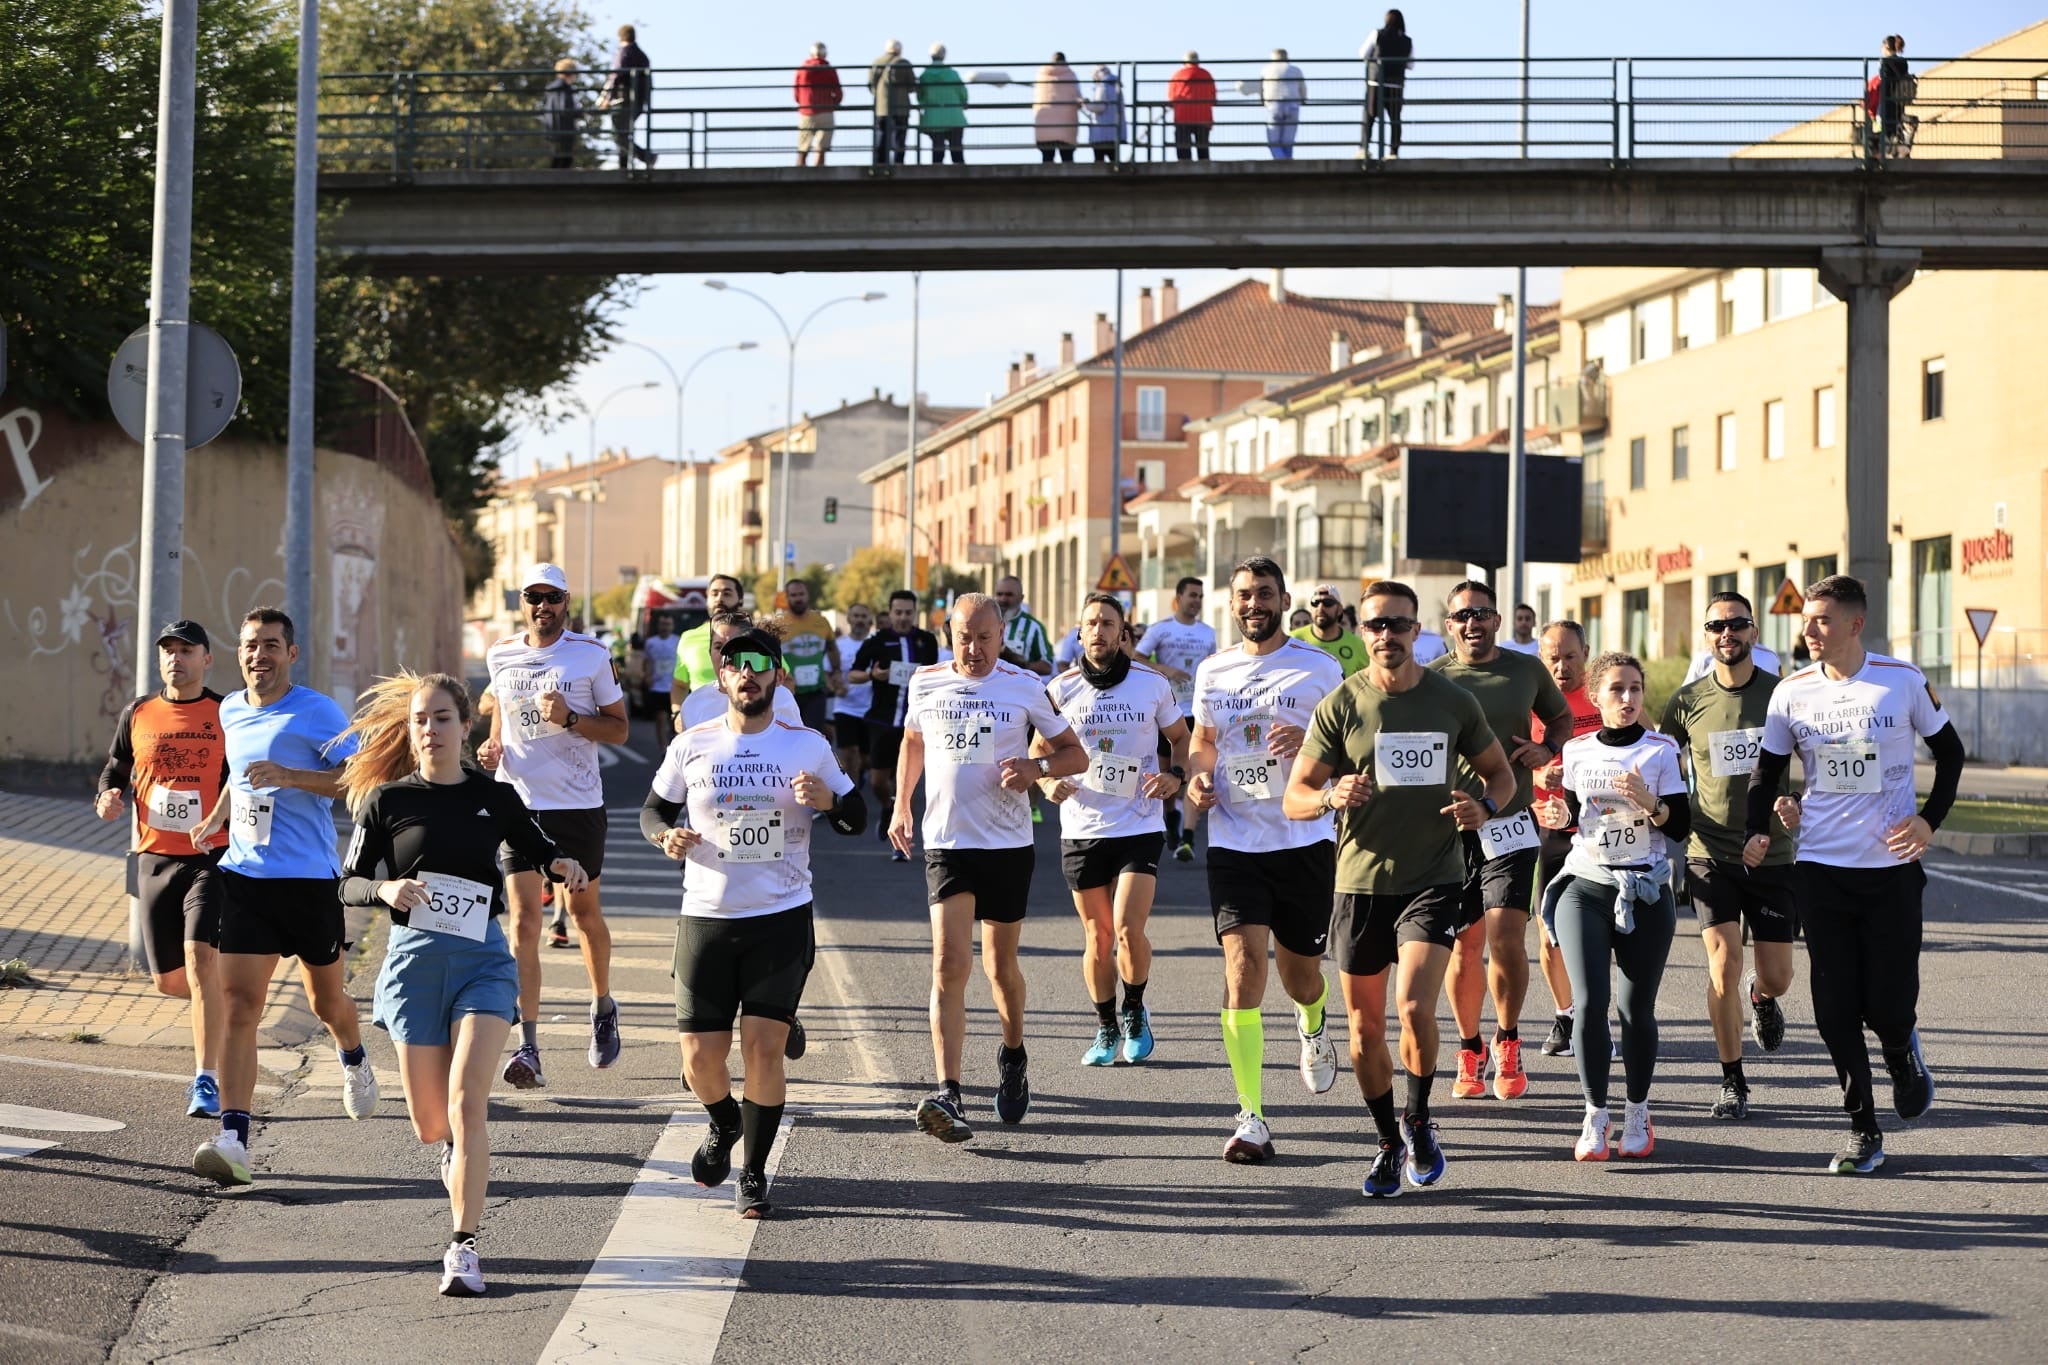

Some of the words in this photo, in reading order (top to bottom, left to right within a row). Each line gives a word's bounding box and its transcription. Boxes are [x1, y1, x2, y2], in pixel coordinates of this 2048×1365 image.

[949, 700, 995, 709] CARRERA
[1091, 703, 1132, 714] CARRERA
[1264, 695, 1297, 709] CIVIL
[520, 709, 550, 727] 30
[977, 711, 1013, 722] CIVIL
[1116, 712, 1146, 723] CIVIL
[1813, 711, 1825, 722] III
[1828, 705, 1877, 720] CARRERA
[1859, 715, 1897, 729] CIVIL
[159, 732, 174, 740] LOS
[944, 731, 981, 750] 284
[1097, 728, 1128, 737] Iberdrola
[1391, 749, 1434, 769] 390
[1723, 742, 1760, 761] 392
[711, 764, 724, 774] III
[728, 763, 782, 775] CARRERA
[1096, 764, 1126, 784] 131
[1235, 766, 1269, 786] 238
[1827, 759, 1866, 778] 310
[762, 775, 795, 789] CIVI
[734, 793, 775, 803] Iberdrola
[158, 802, 189, 819] 188
[235, 804, 258, 826] 305
[729, 826, 769, 846] 500
[1490, 821, 1526, 843] 510
[1598, 827, 1637, 848] 478
[429, 891, 475, 918] 537
